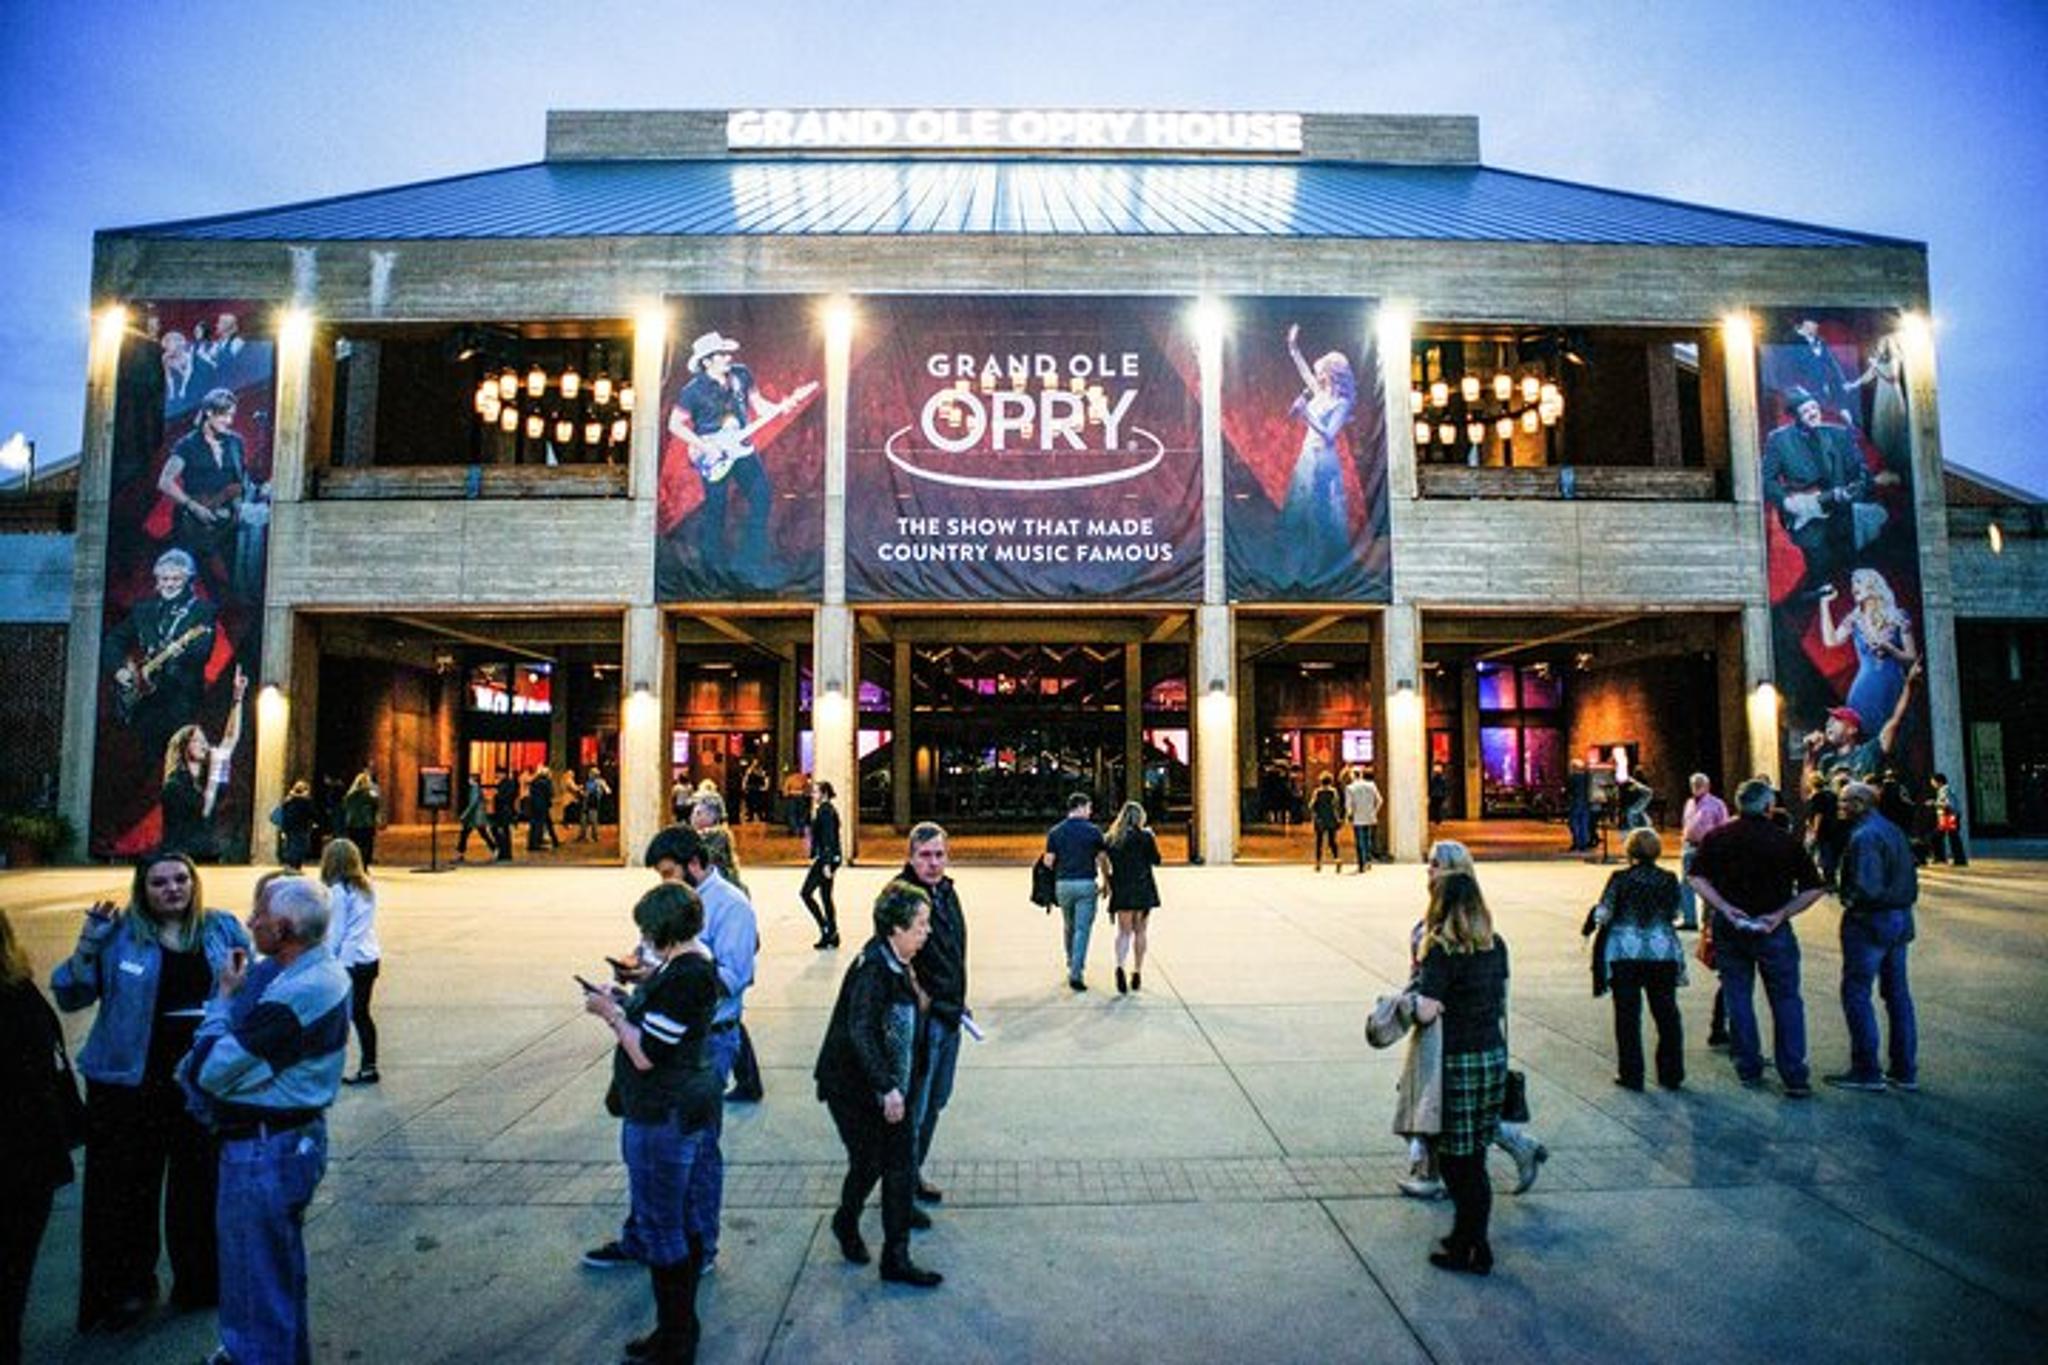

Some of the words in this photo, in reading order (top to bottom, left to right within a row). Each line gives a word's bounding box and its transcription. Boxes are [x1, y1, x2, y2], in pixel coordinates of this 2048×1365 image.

[728, 110, 896, 147] GRAND
[905, 110, 1001, 147] OLE
[1008, 110, 1136, 148] OPRY
[1152, 111, 1302, 150] HOUSE
[927, 354, 1058, 377] GRAND
[1069, 354, 1139, 377] OLE
[920, 387, 1139, 453] OPRY
[897, 517, 940, 536] THE
[946, 517, 1017, 536] SHOW
[1022, 518, 1082, 536] THAT
[1086, 518, 1154, 536] MADE
[877, 543, 988, 562] COUNTRY
[995, 544, 1069, 562] MUSIC
[1076, 544, 1173, 562] FAMOUS
